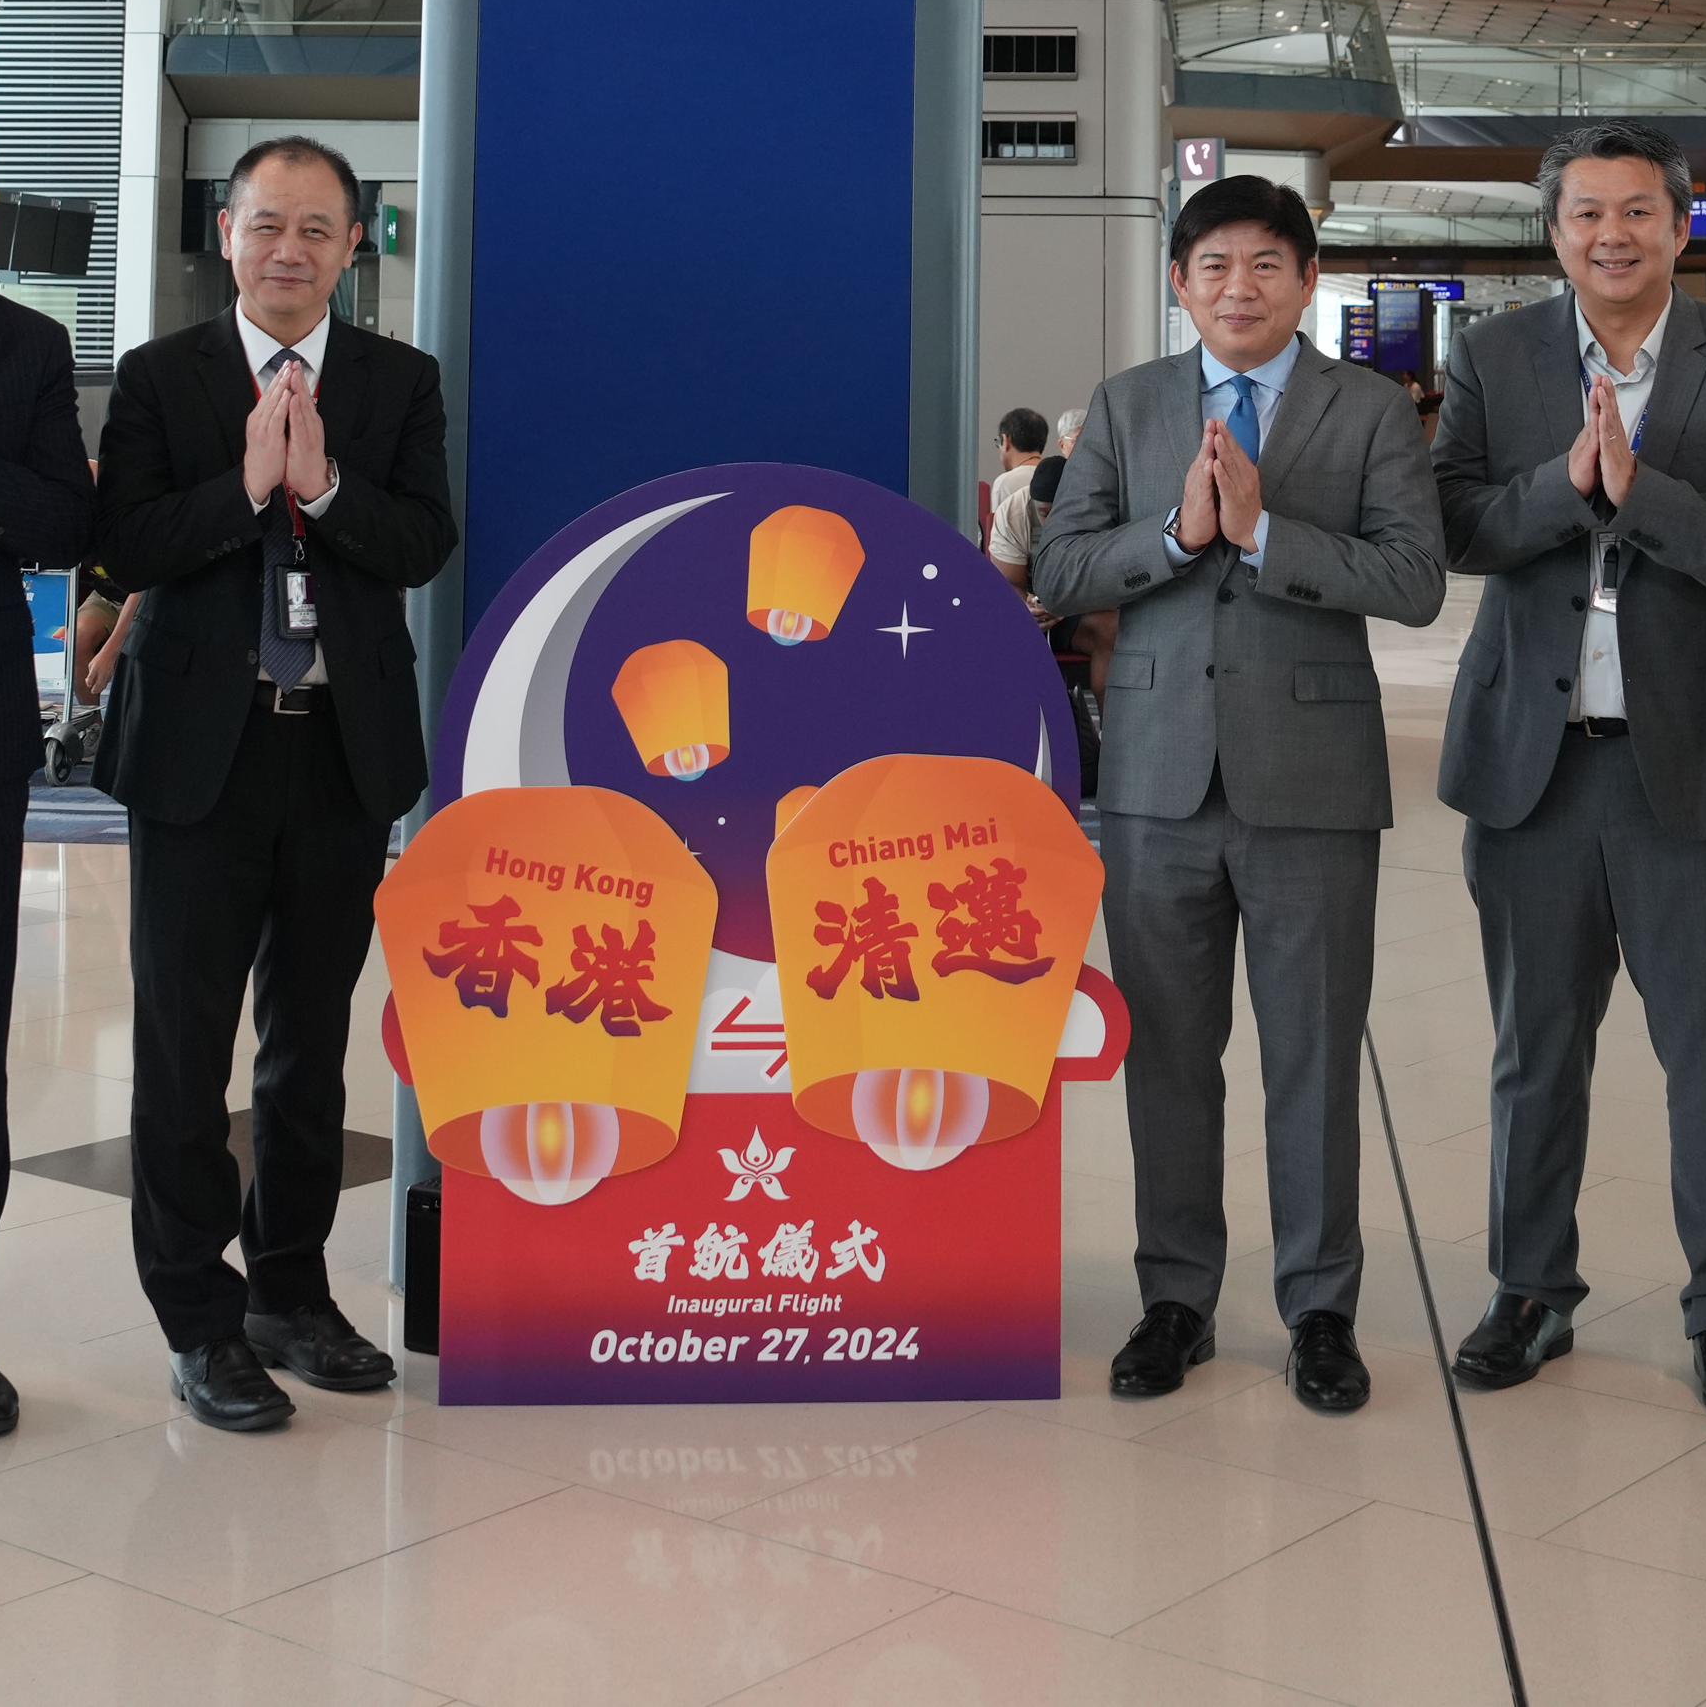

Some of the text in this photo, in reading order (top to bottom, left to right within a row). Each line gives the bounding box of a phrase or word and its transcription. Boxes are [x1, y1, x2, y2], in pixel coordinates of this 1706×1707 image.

[828, 818, 998, 868] Chiang Mai
[485, 846, 654, 908] Hong Kong
[806, 857, 1057, 1002] 清邁
[423, 894, 674, 1037] 香港
[628, 1219, 886, 1283] 首航儀式
[667, 1294, 843, 1317] Inaugural Flight
[590, 1326, 920, 1365] October 27, 2024
